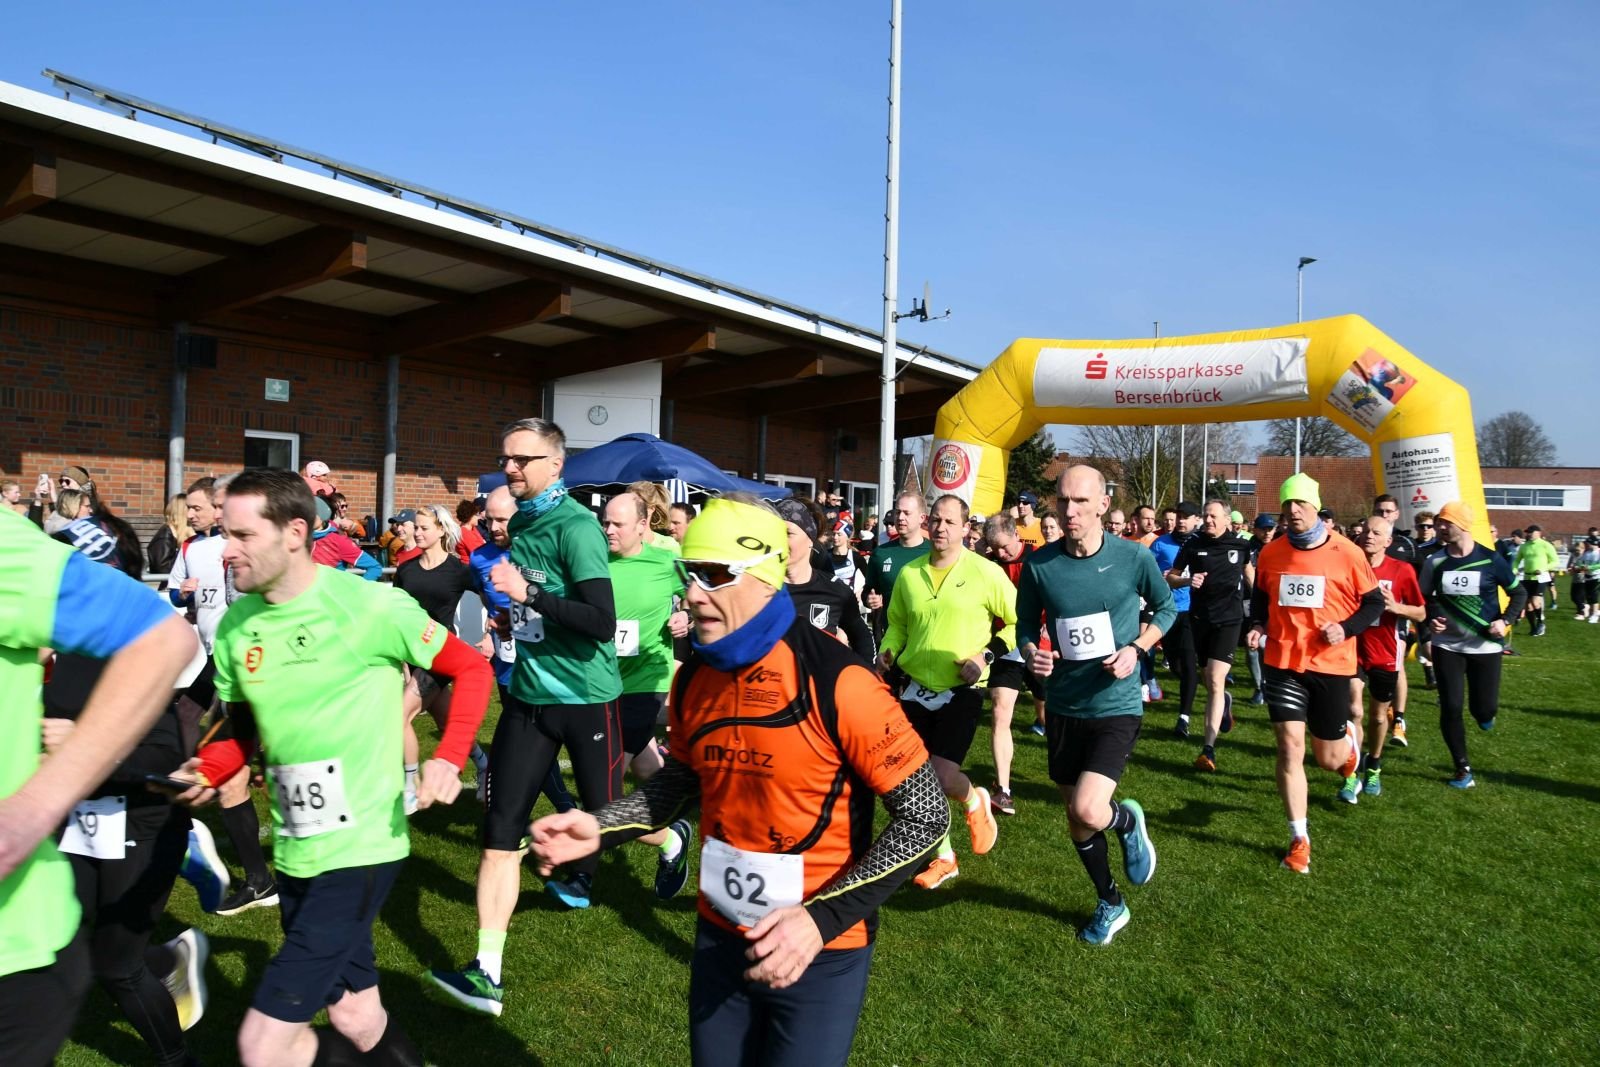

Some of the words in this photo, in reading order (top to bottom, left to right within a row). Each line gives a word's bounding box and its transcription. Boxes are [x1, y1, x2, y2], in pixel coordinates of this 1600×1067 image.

[1115, 362, 1244, 382] Kreissparkasse
[1115, 388, 1223, 405] Bersenbrück
[1391, 447, 1440, 459] Autohaus
[940, 459, 956, 471] Oma
[1287, 582, 1315, 597] 368
[1451, 576, 1469, 588] 49
[200, 588, 218, 604] 57
[512, 604, 529, 627] 54
[1068, 626, 1095, 647] 58
[916, 685, 938, 702] 82
[724, 866, 768, 907] 62
